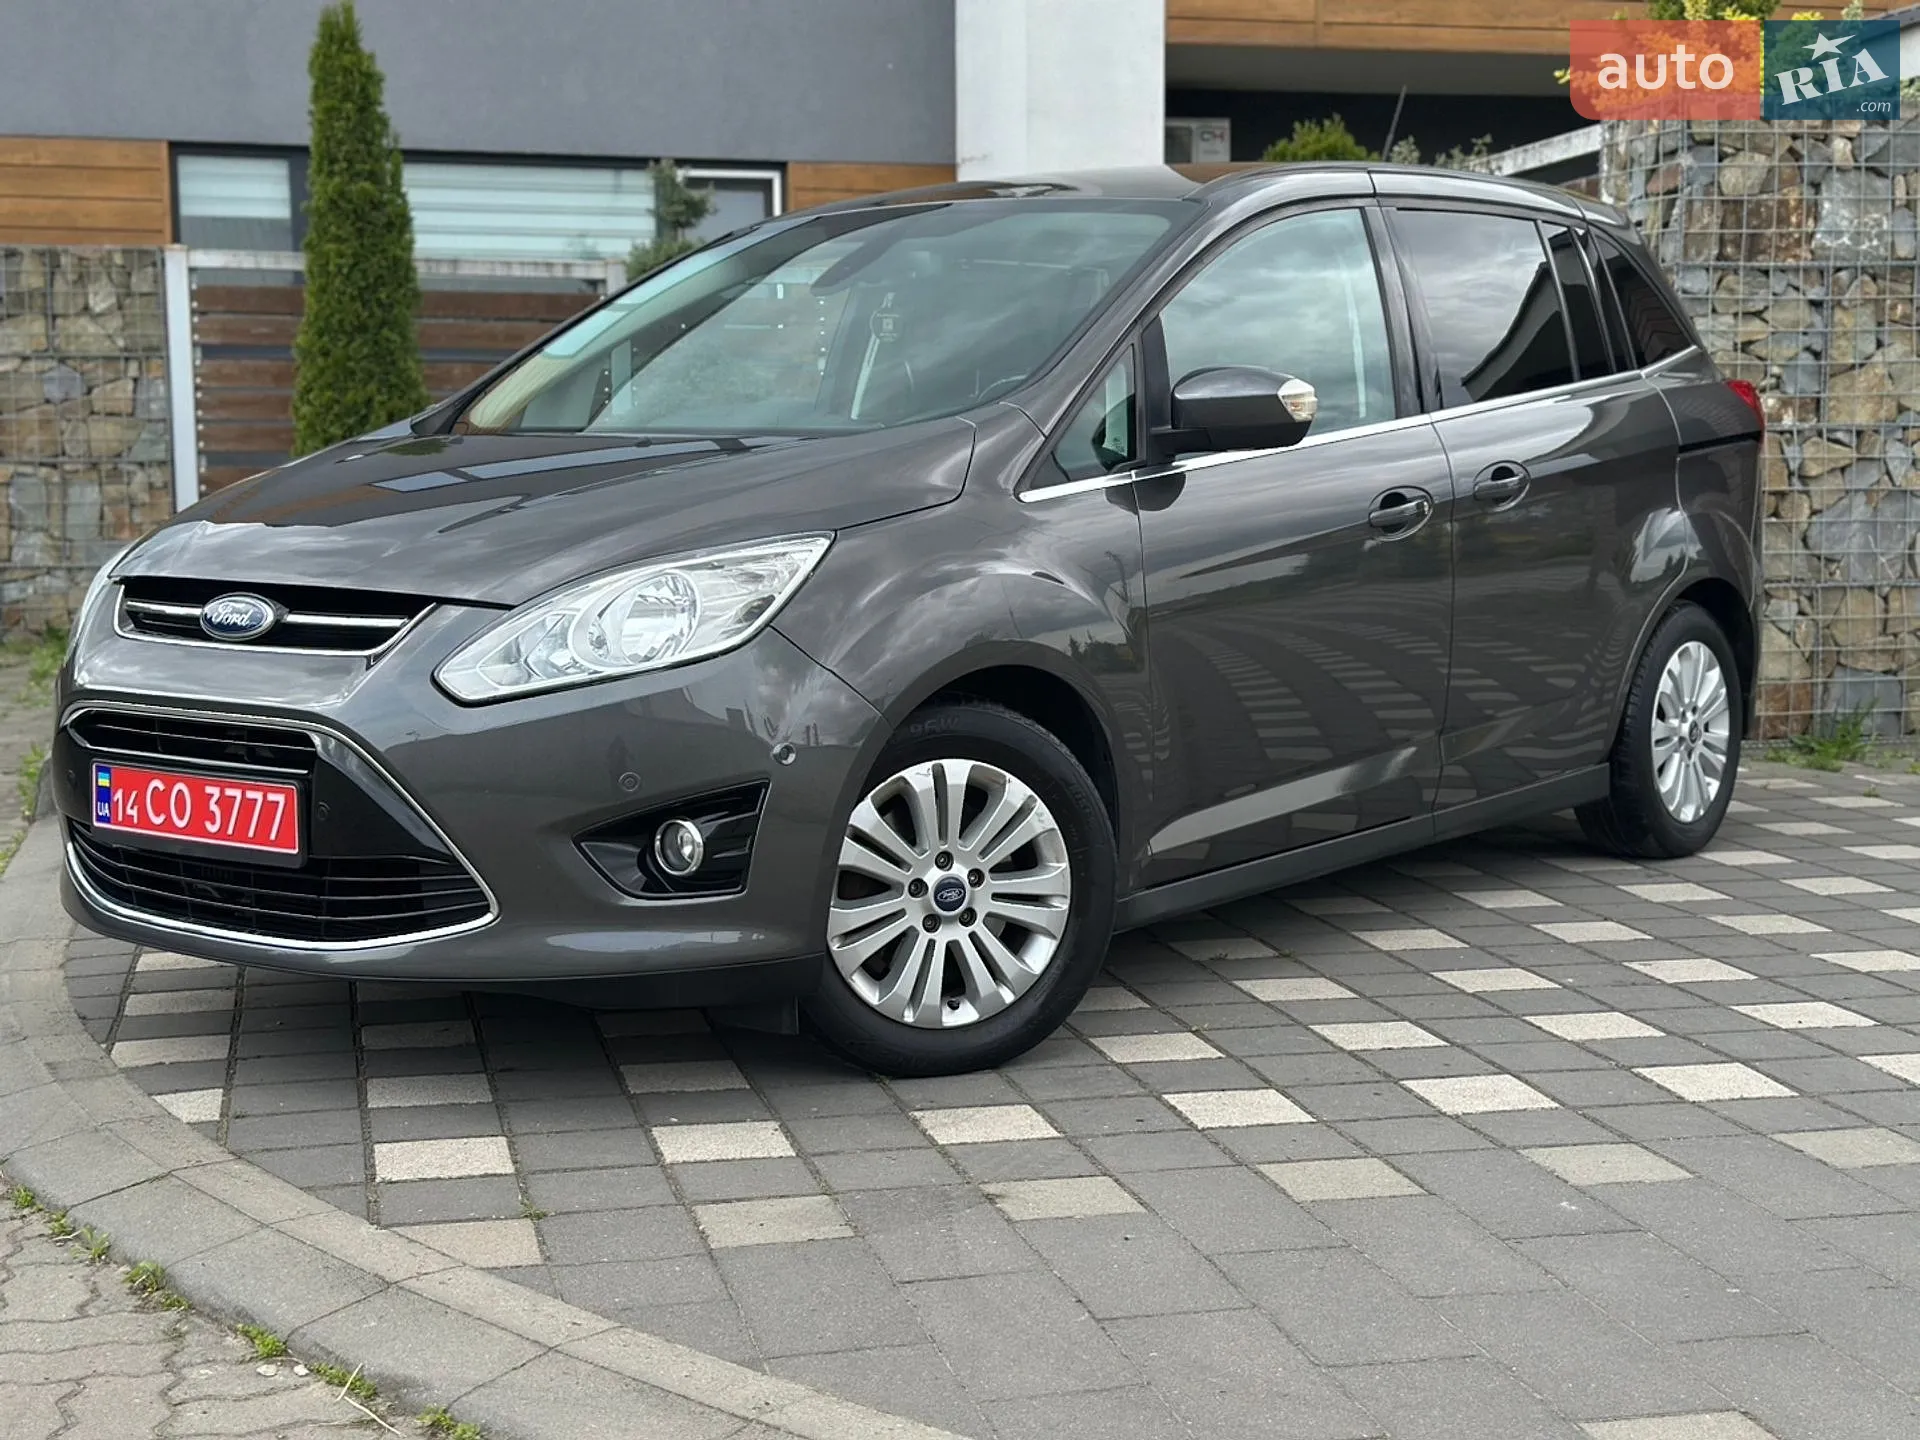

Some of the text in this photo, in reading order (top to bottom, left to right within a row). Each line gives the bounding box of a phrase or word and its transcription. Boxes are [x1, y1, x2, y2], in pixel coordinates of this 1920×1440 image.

[211, 601, 254, 627] Ford
[97, 801, 111, 818] UA
[113, 778, 286, 842] 14 CO 3777
